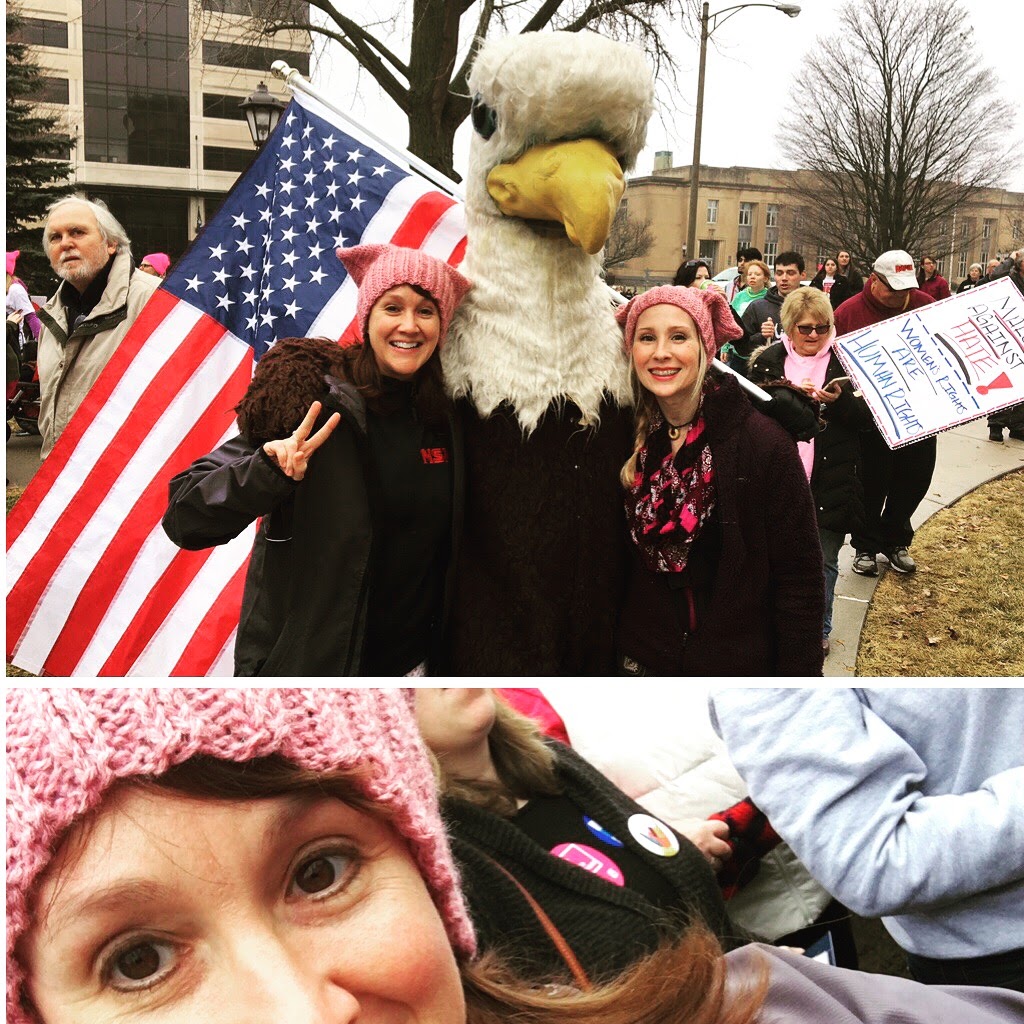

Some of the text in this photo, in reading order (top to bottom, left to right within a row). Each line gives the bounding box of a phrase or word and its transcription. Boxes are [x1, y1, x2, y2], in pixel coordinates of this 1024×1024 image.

[846, 330, 898, 390] HUMAN
[892, 347, 924, 381] ARE
[968, 303, 1024, 370] AGAINST
